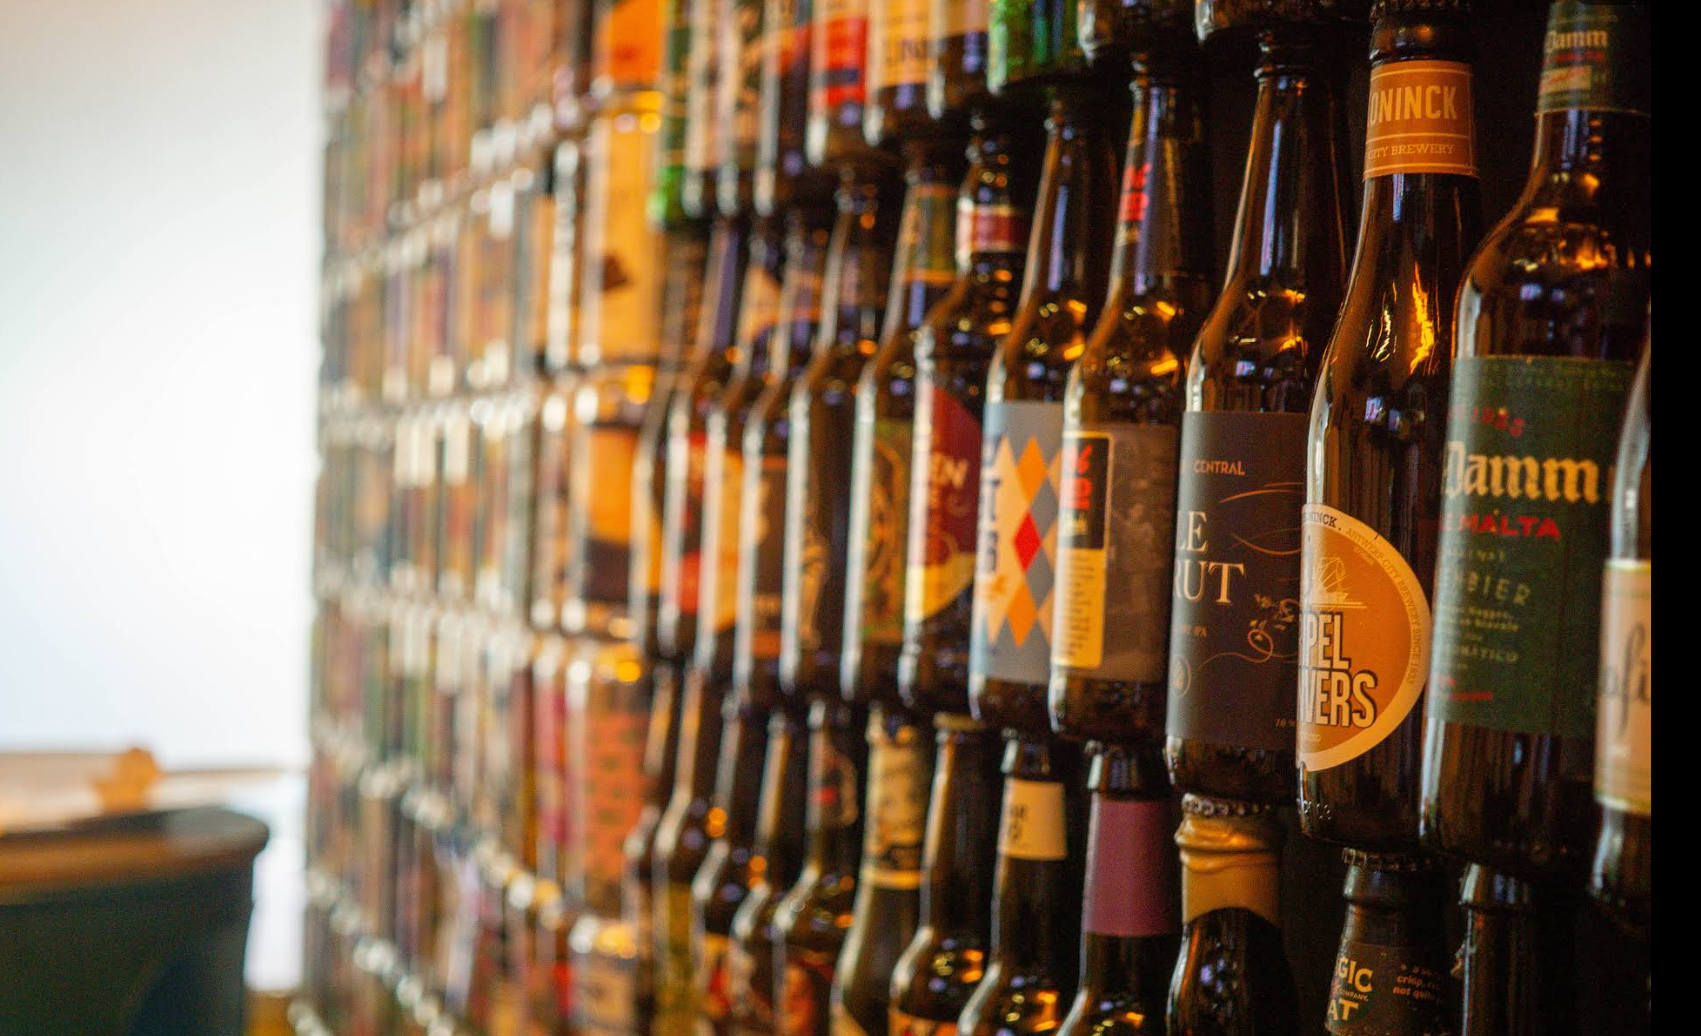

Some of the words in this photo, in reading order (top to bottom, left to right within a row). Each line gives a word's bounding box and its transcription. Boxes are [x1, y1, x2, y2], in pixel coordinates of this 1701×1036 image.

[1390, 141, 1456, 157] BREWERY
[1193, 459, 1246, 476] CENTRAL
[1443, 441, 1600, 504] Damm
